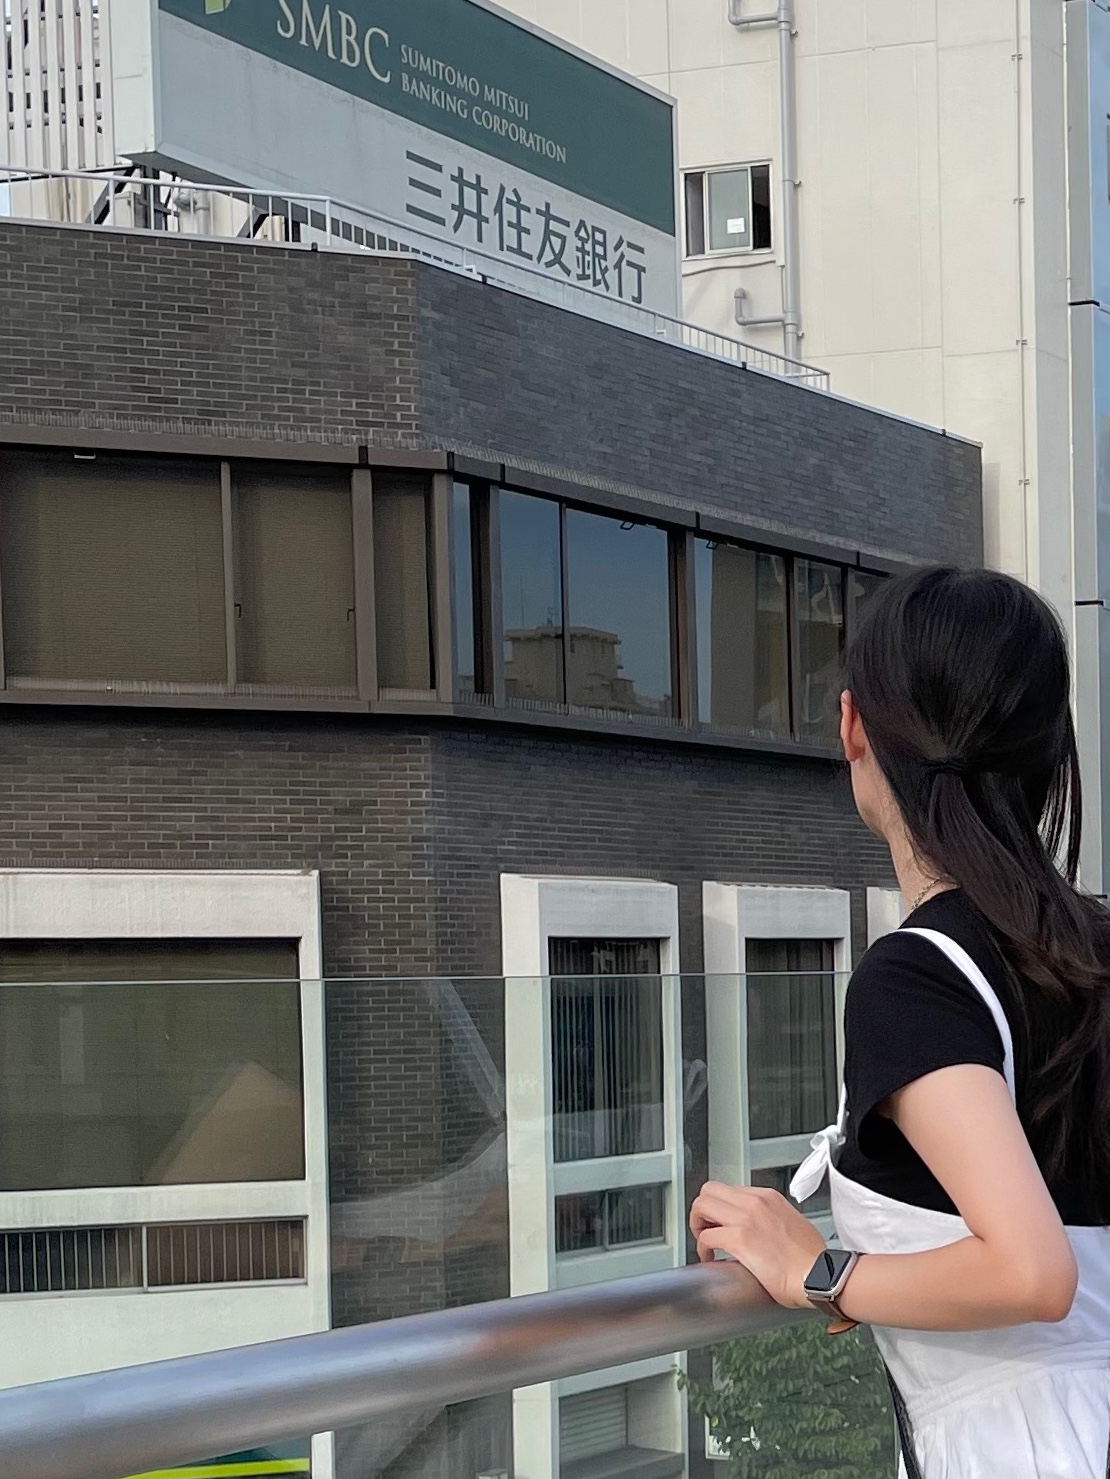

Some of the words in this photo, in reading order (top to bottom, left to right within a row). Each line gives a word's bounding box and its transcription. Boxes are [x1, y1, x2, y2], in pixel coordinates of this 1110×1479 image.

[276, 0, 391, 84] SMBC
[401, 44, 480, 99] SUMITOMO
[483, 81, 530, 121] MITSUI
[401, 74, 468, 120] BANKING
[472, 104, 567, 164] CORPORATION
[405, 150, 647, 305] 三井住友銀行
